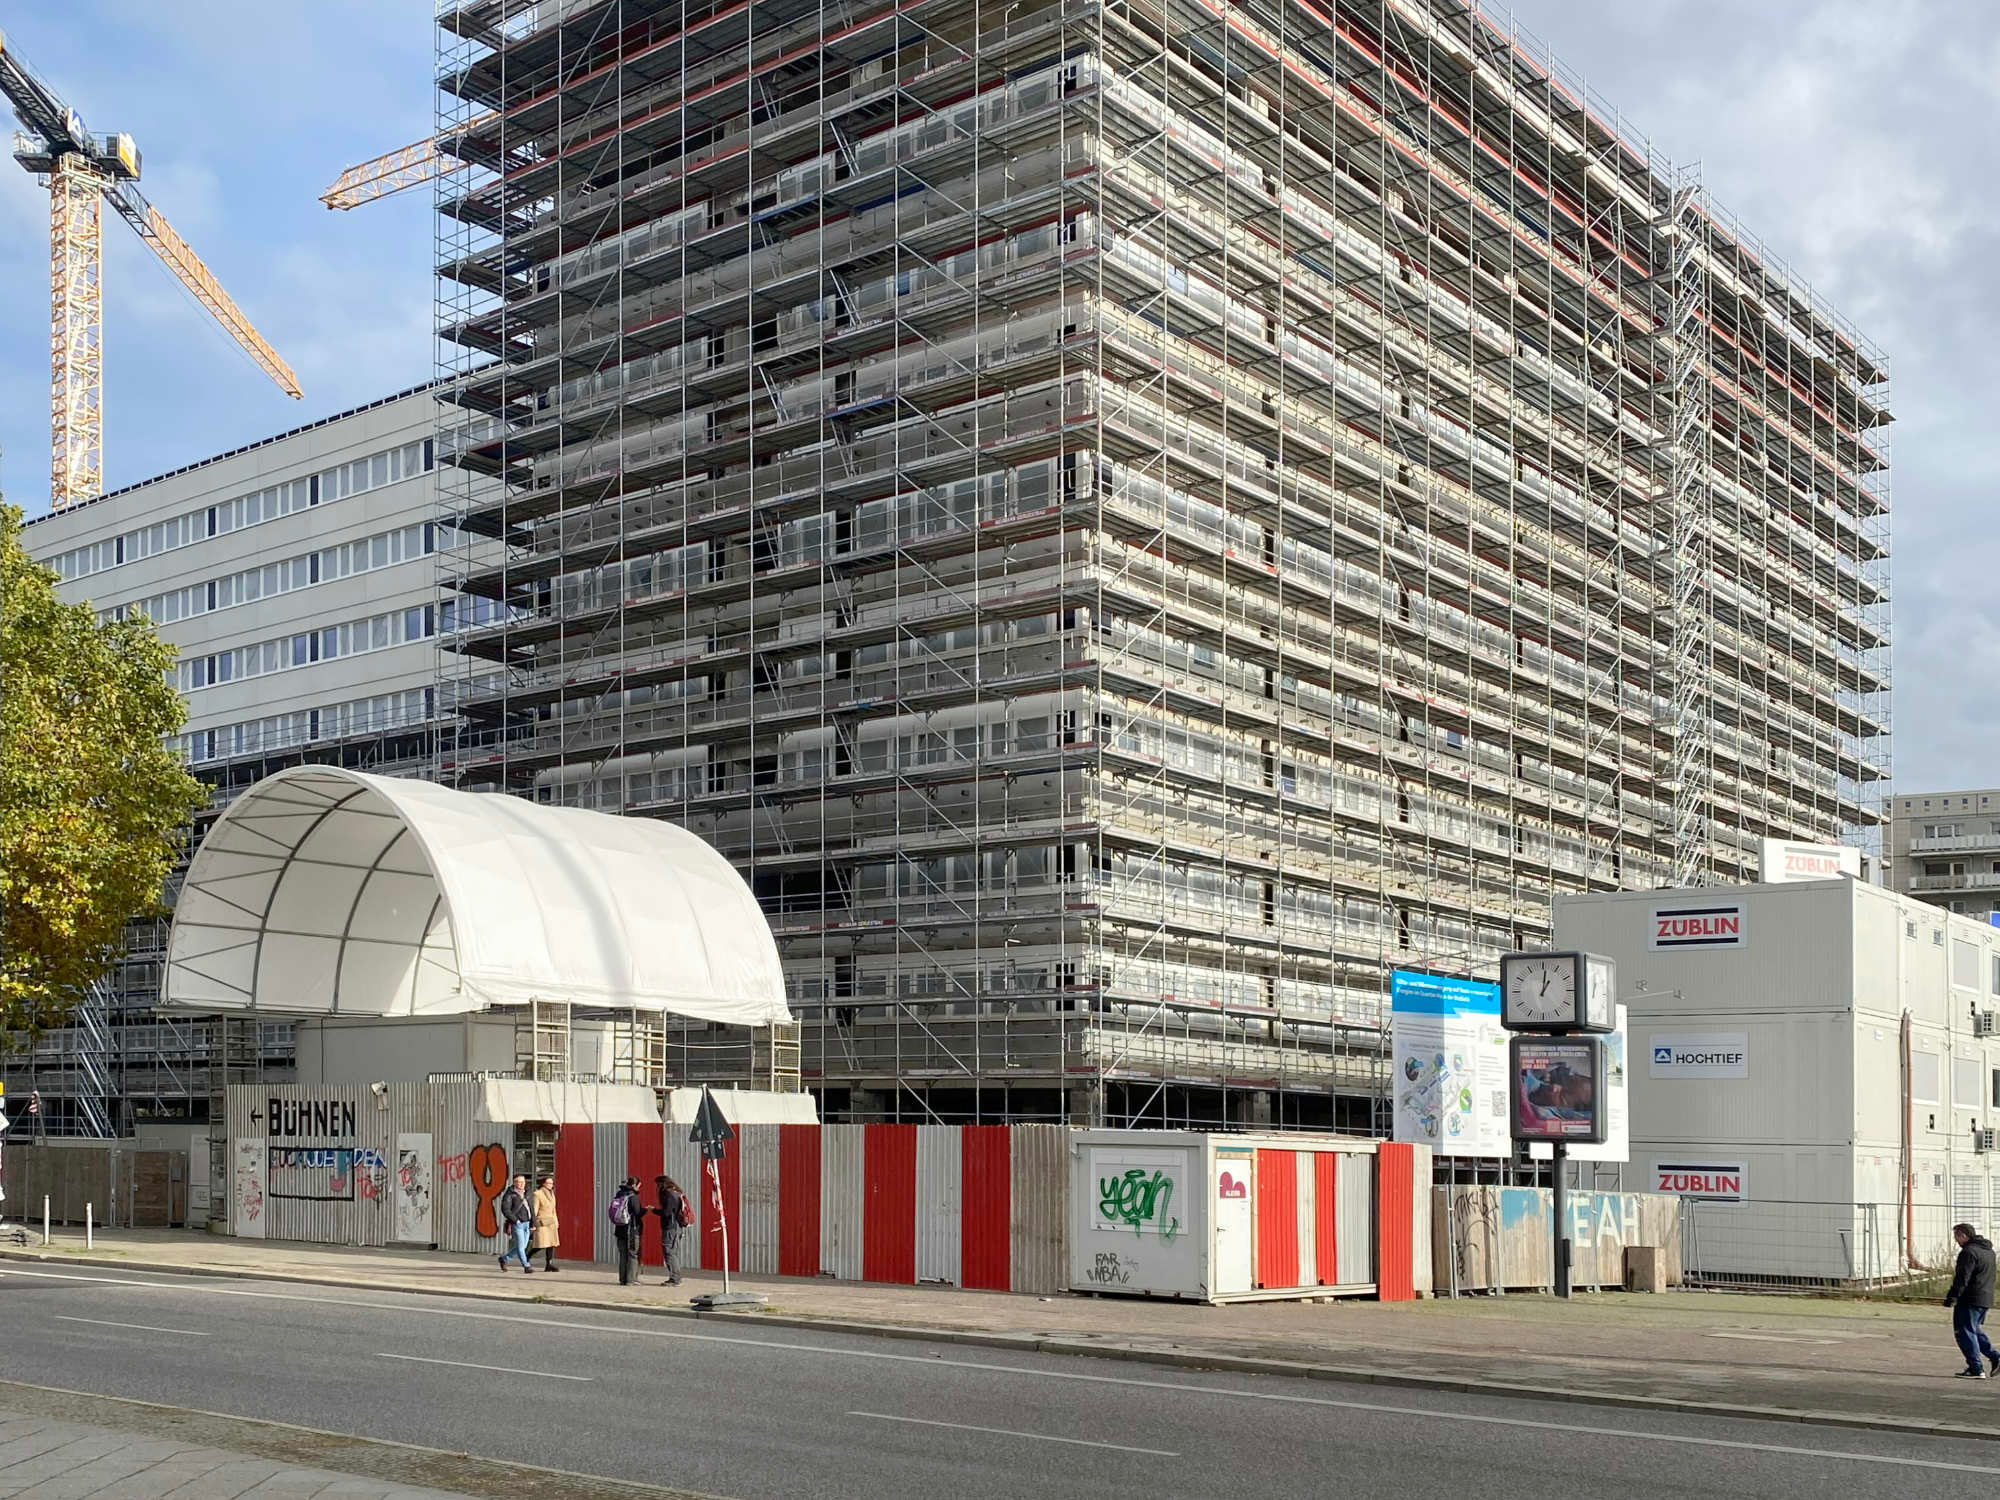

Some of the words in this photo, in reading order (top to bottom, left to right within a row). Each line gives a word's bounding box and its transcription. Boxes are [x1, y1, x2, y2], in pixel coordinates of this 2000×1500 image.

[1784, 855, 1841, 874] ZÜBLIN
[1656, 917, 1739, 937] ZÜBLIN
[1676, 1053, 1743, 1064] HOCHTIEF
[268, 1098, 355, 1137] BÜHNEN
[1658, 1173, 1740, 1193] ZÜBLIN
